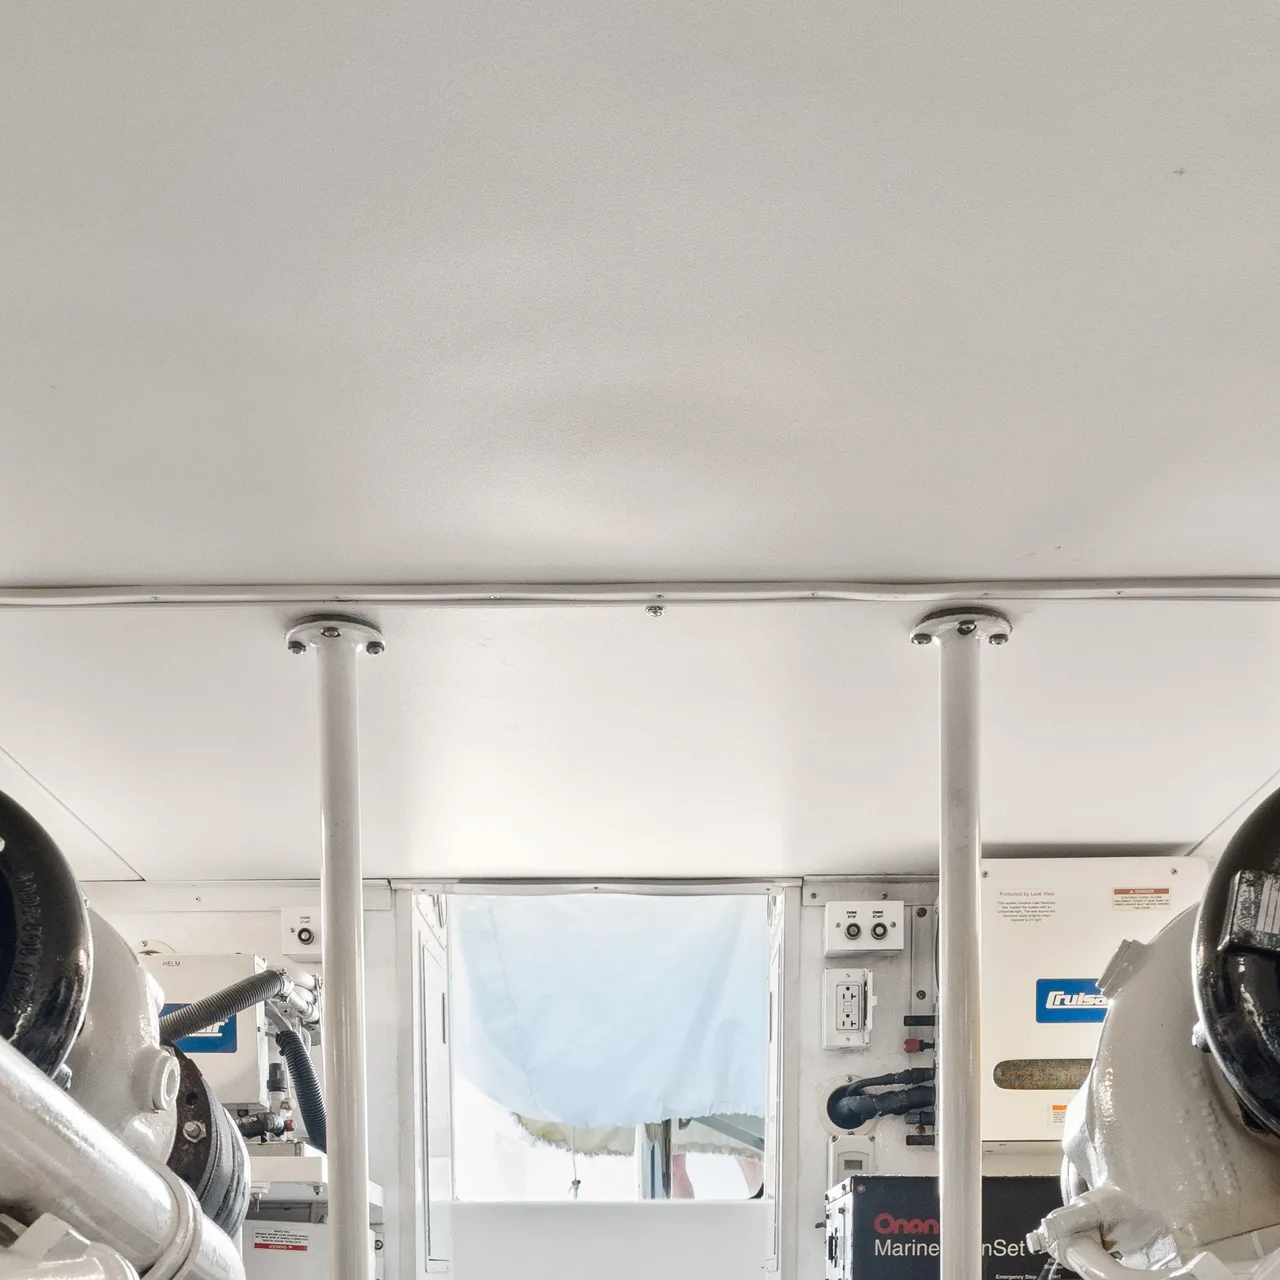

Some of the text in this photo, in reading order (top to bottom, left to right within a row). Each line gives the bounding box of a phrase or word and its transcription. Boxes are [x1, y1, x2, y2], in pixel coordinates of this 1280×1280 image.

[874, 1213, 939, 1234] Onan
[874, 1239, 1025, 1257] Marine nSet
